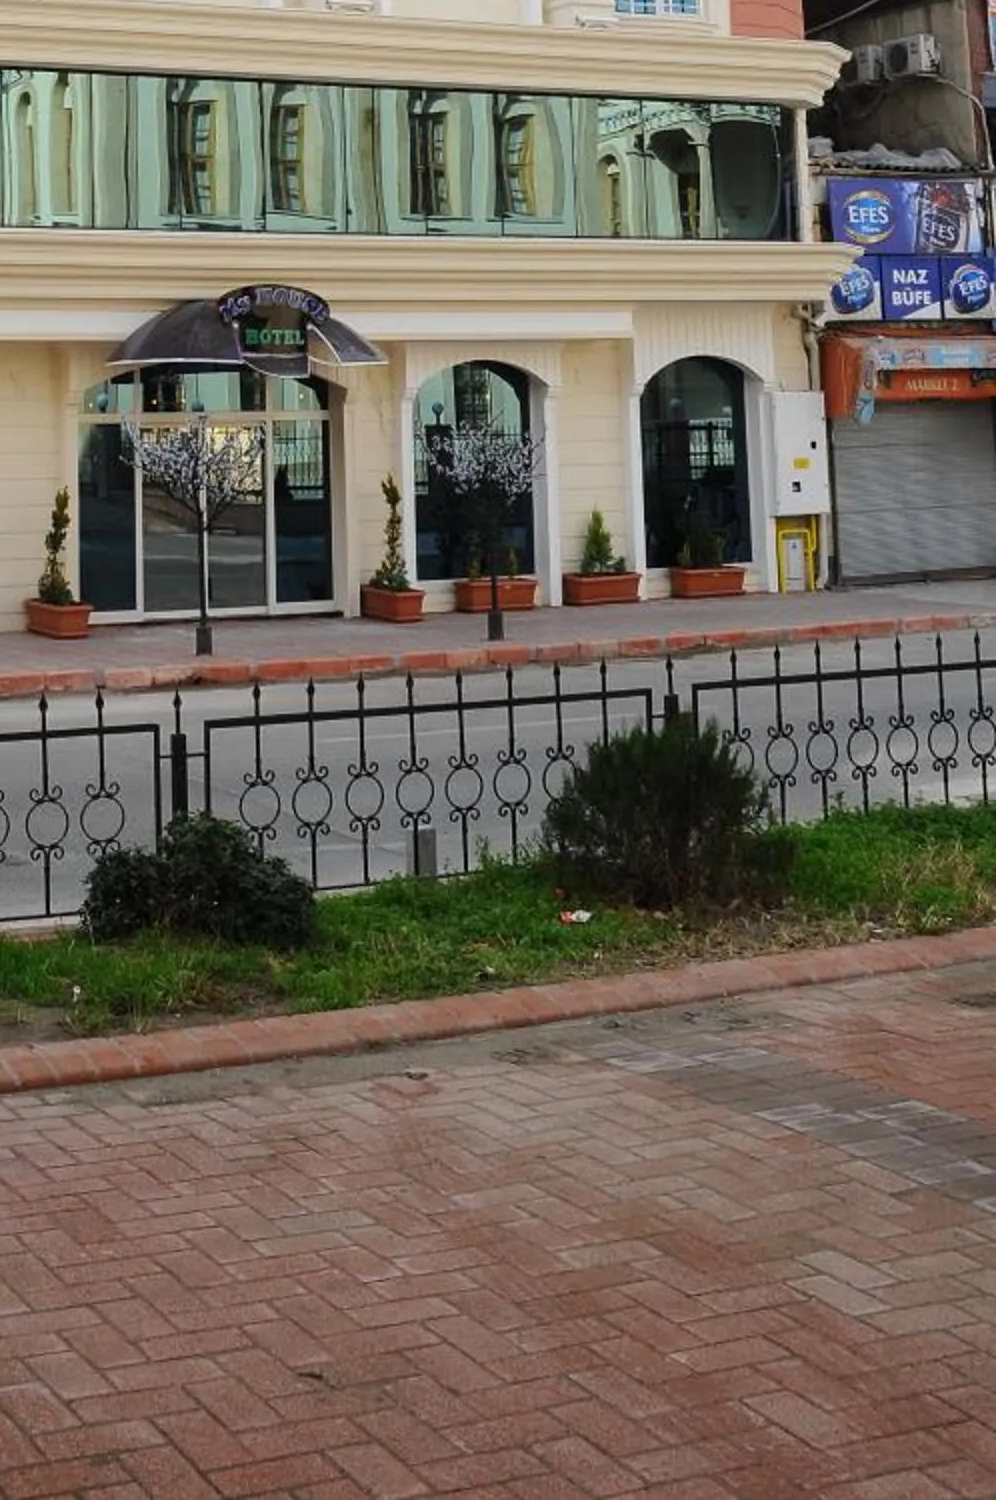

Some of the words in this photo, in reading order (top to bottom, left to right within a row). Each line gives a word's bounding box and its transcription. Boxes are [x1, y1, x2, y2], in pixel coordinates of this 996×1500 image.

[849, 205, 889, 224] EFES
[923, 217, 955, 241] EFES
[892, 269, 928, 285] NAZ
[959, 275, 988, 296] EFES
[891, 287, 933, 306] BÜFE
[245, 329, 305, 345] HOTEL
